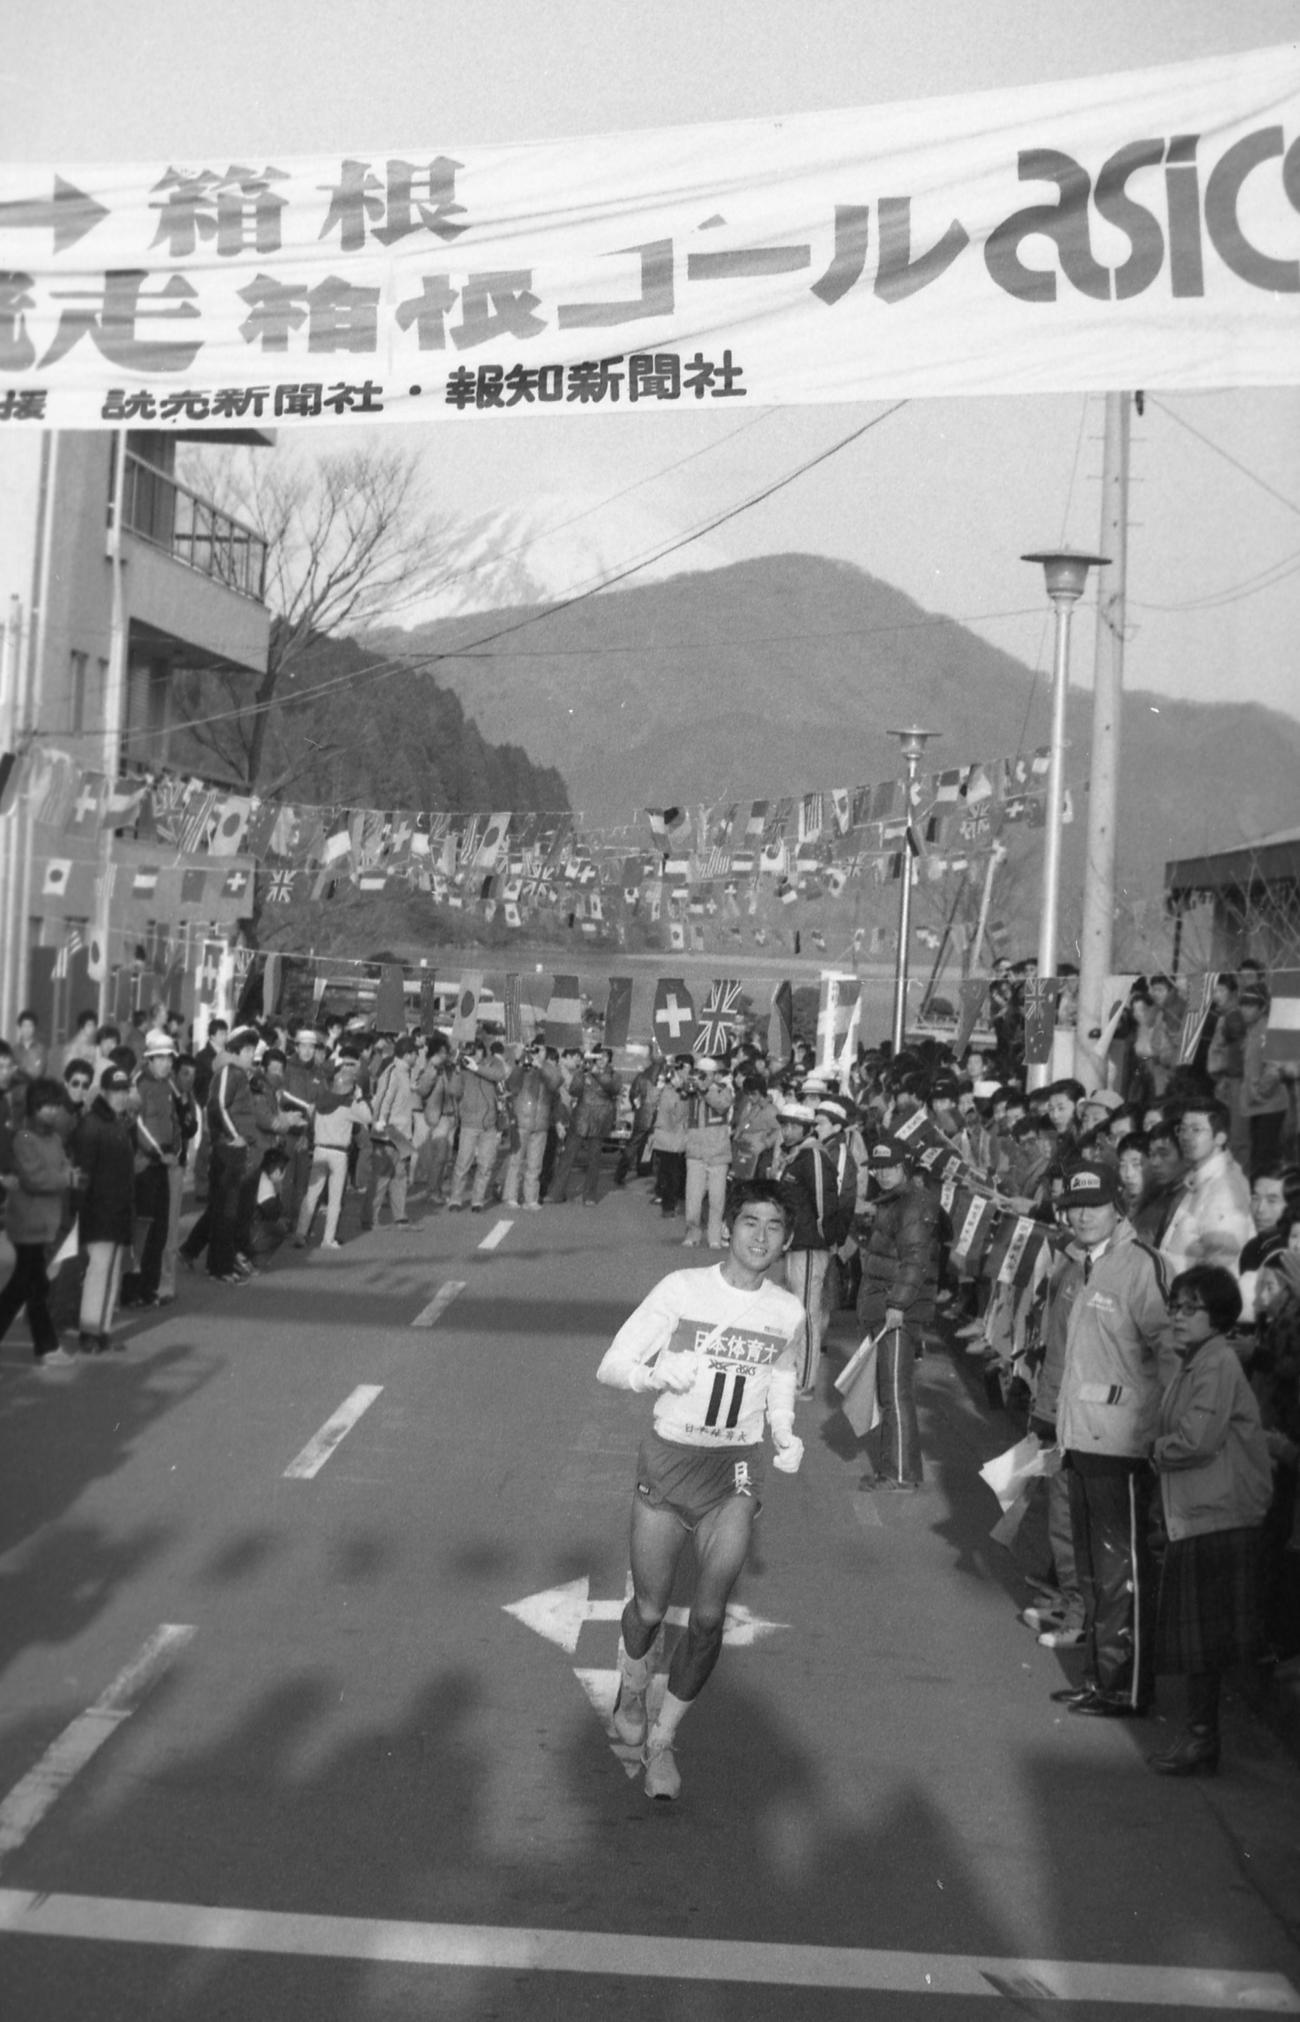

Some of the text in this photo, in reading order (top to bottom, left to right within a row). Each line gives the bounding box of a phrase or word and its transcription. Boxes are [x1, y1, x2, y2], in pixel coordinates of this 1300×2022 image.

[148, 155, 472, 257] 箱根
[984, 125, 1300, 302] asic
[704, 1371, 746, 1429] 11
